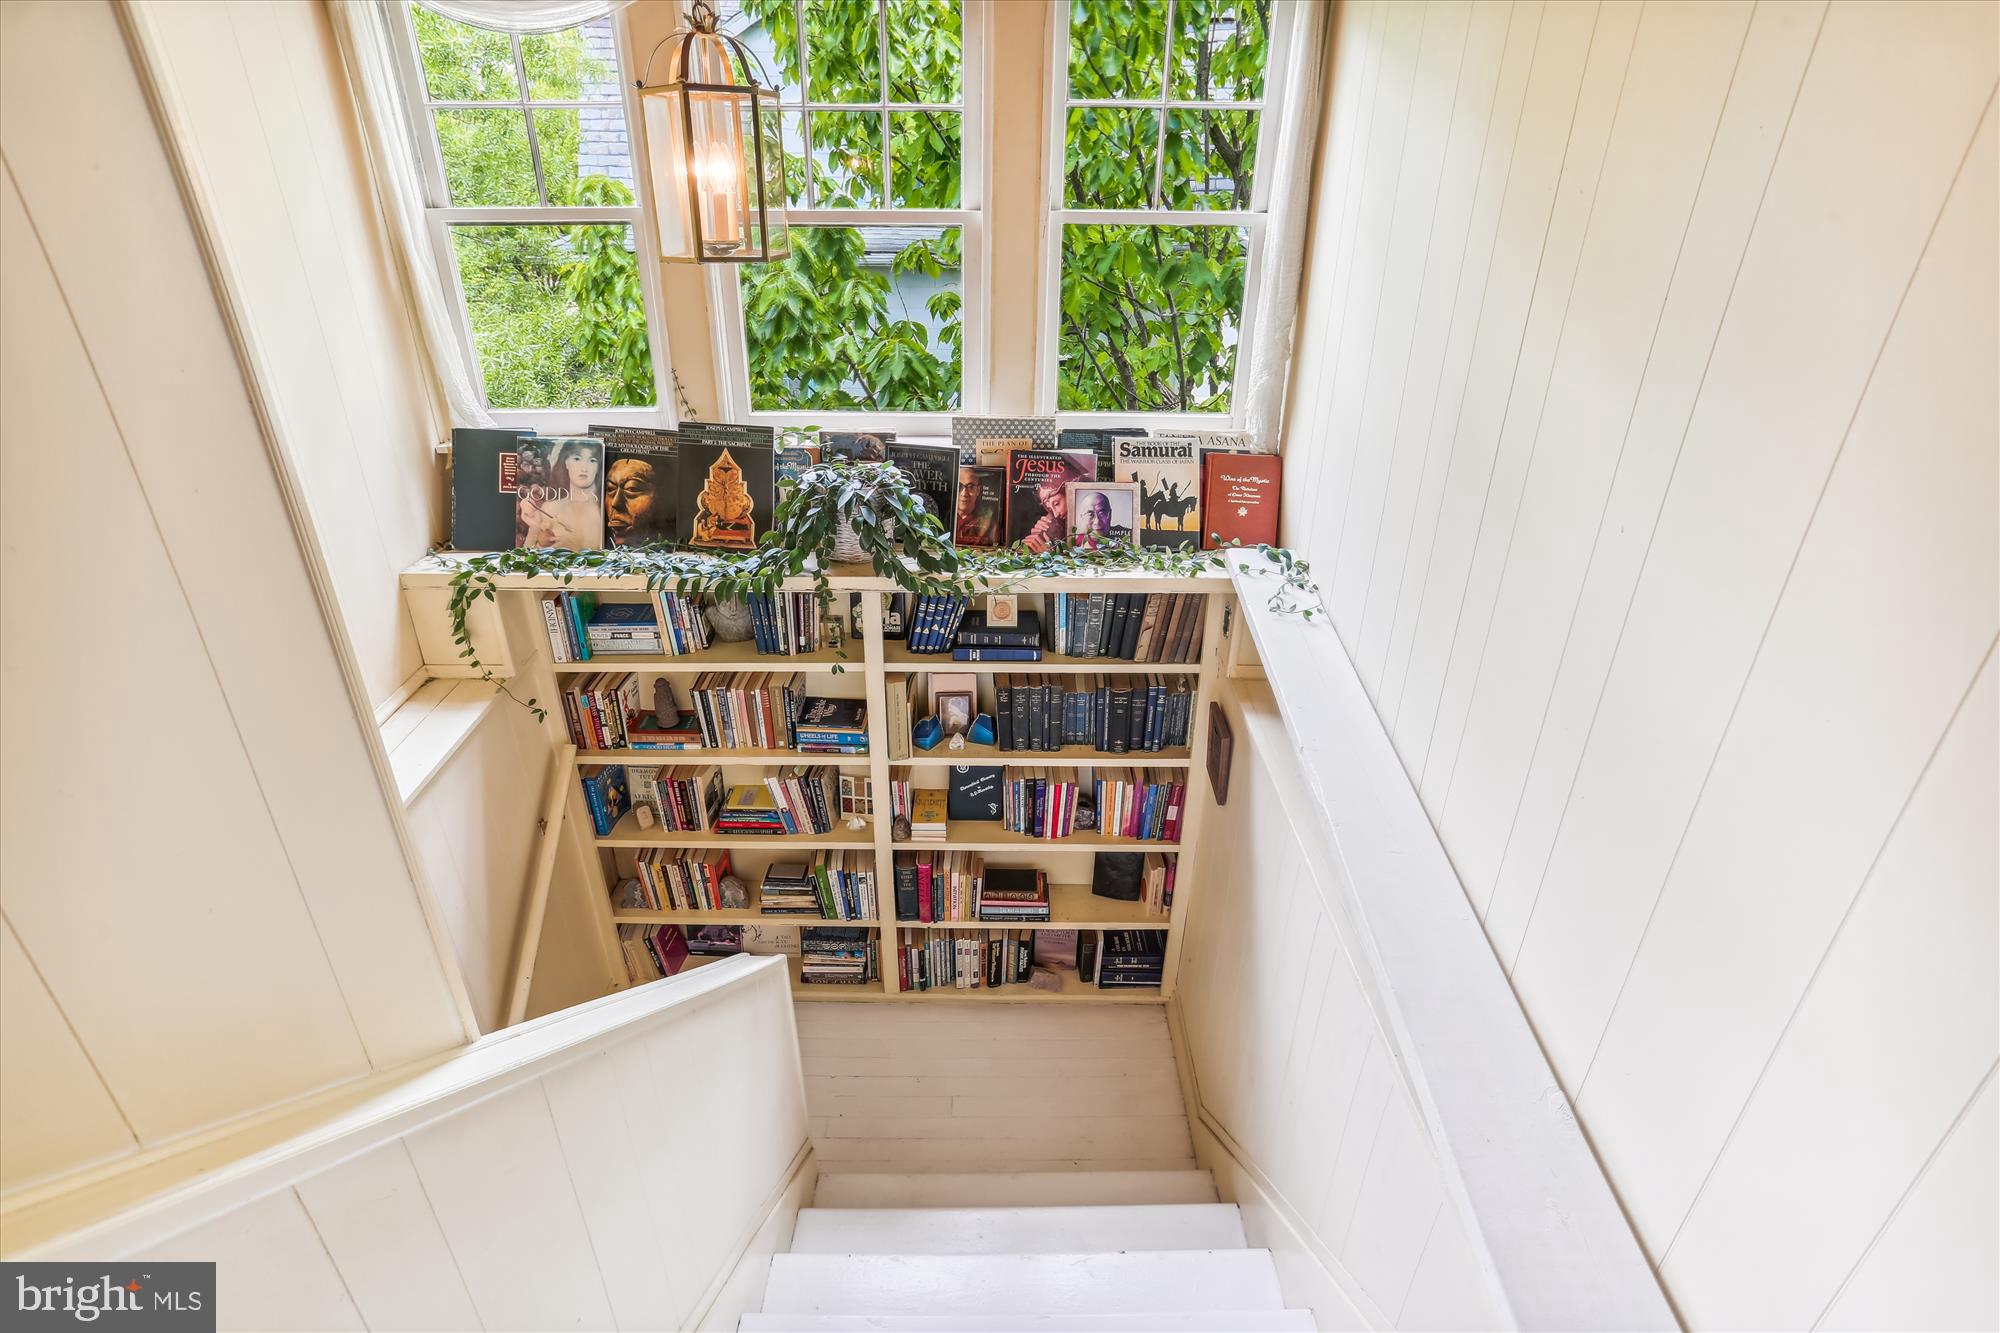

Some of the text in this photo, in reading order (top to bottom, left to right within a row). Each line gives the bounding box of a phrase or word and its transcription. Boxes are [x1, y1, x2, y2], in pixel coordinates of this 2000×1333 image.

[1207, 436, 1246, 447] ASANA
[1119, 442, 1193, 458] Samurai
[912, 460, 931, 470] THE
[1013, 458, 1065, 484] Jesus
[517, 486, 599, 501] GODD
[543, 600, 559, 634] GANDHI
